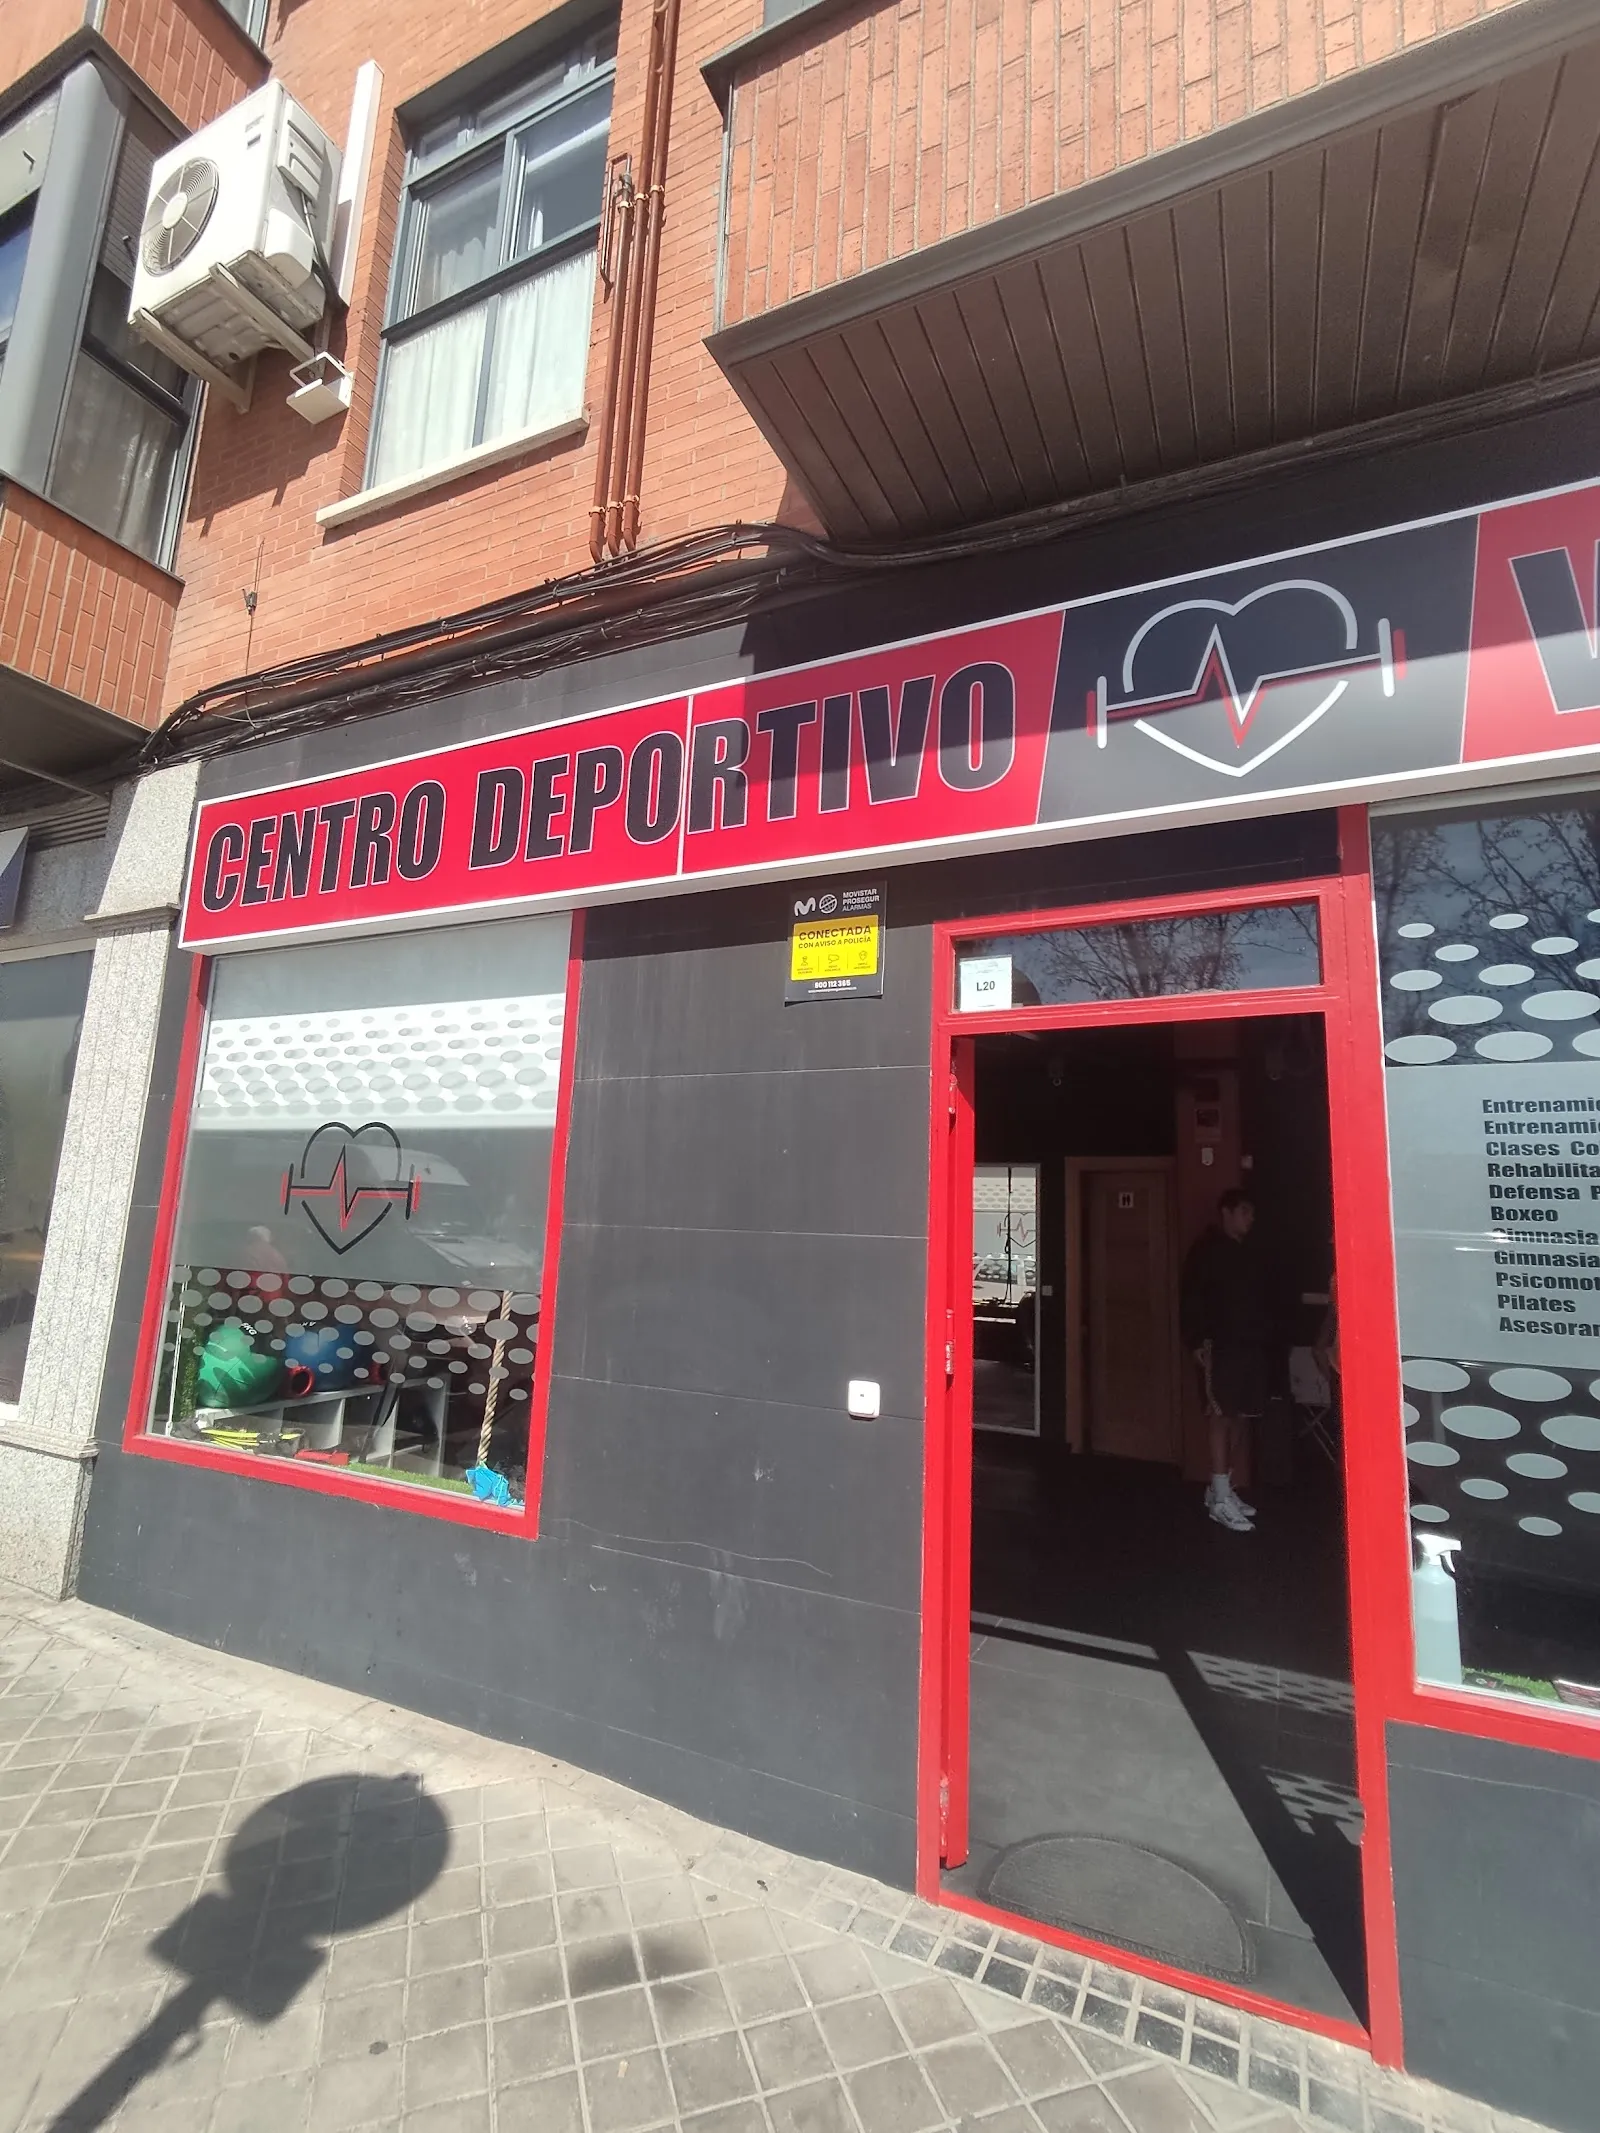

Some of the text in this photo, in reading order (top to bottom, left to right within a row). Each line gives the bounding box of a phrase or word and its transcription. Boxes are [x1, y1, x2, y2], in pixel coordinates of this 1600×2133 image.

[201, 661, 1015, 912] CENTRO DEPORTIVO
[842, 895, 880, 905] PROSEGUR
[843, 888, 877, 899] MOVISTAR
[842, 903, 872, 912] ALARMAS
[799, 925, 871, 941] CONECTADA
[814, 940, 836, 948] AVISO
[844, 936, 871, 945] POLICÍA
[976, 980, 996, 992] L20
[1484, 1119, 1600, 1135] Entrenami
[1486, 1141, 1560, 1156] Clases
[1487, 1163, 1600, 1178] Rehabilita
[1489, 1184, 1580, 1200] Defensa
[1491, 1206, 1558, 1221] Boxeo
[1494, 1250, 1600, 1268] Gimnasia
[1497, 1294, 1576, 1313] Pilates
